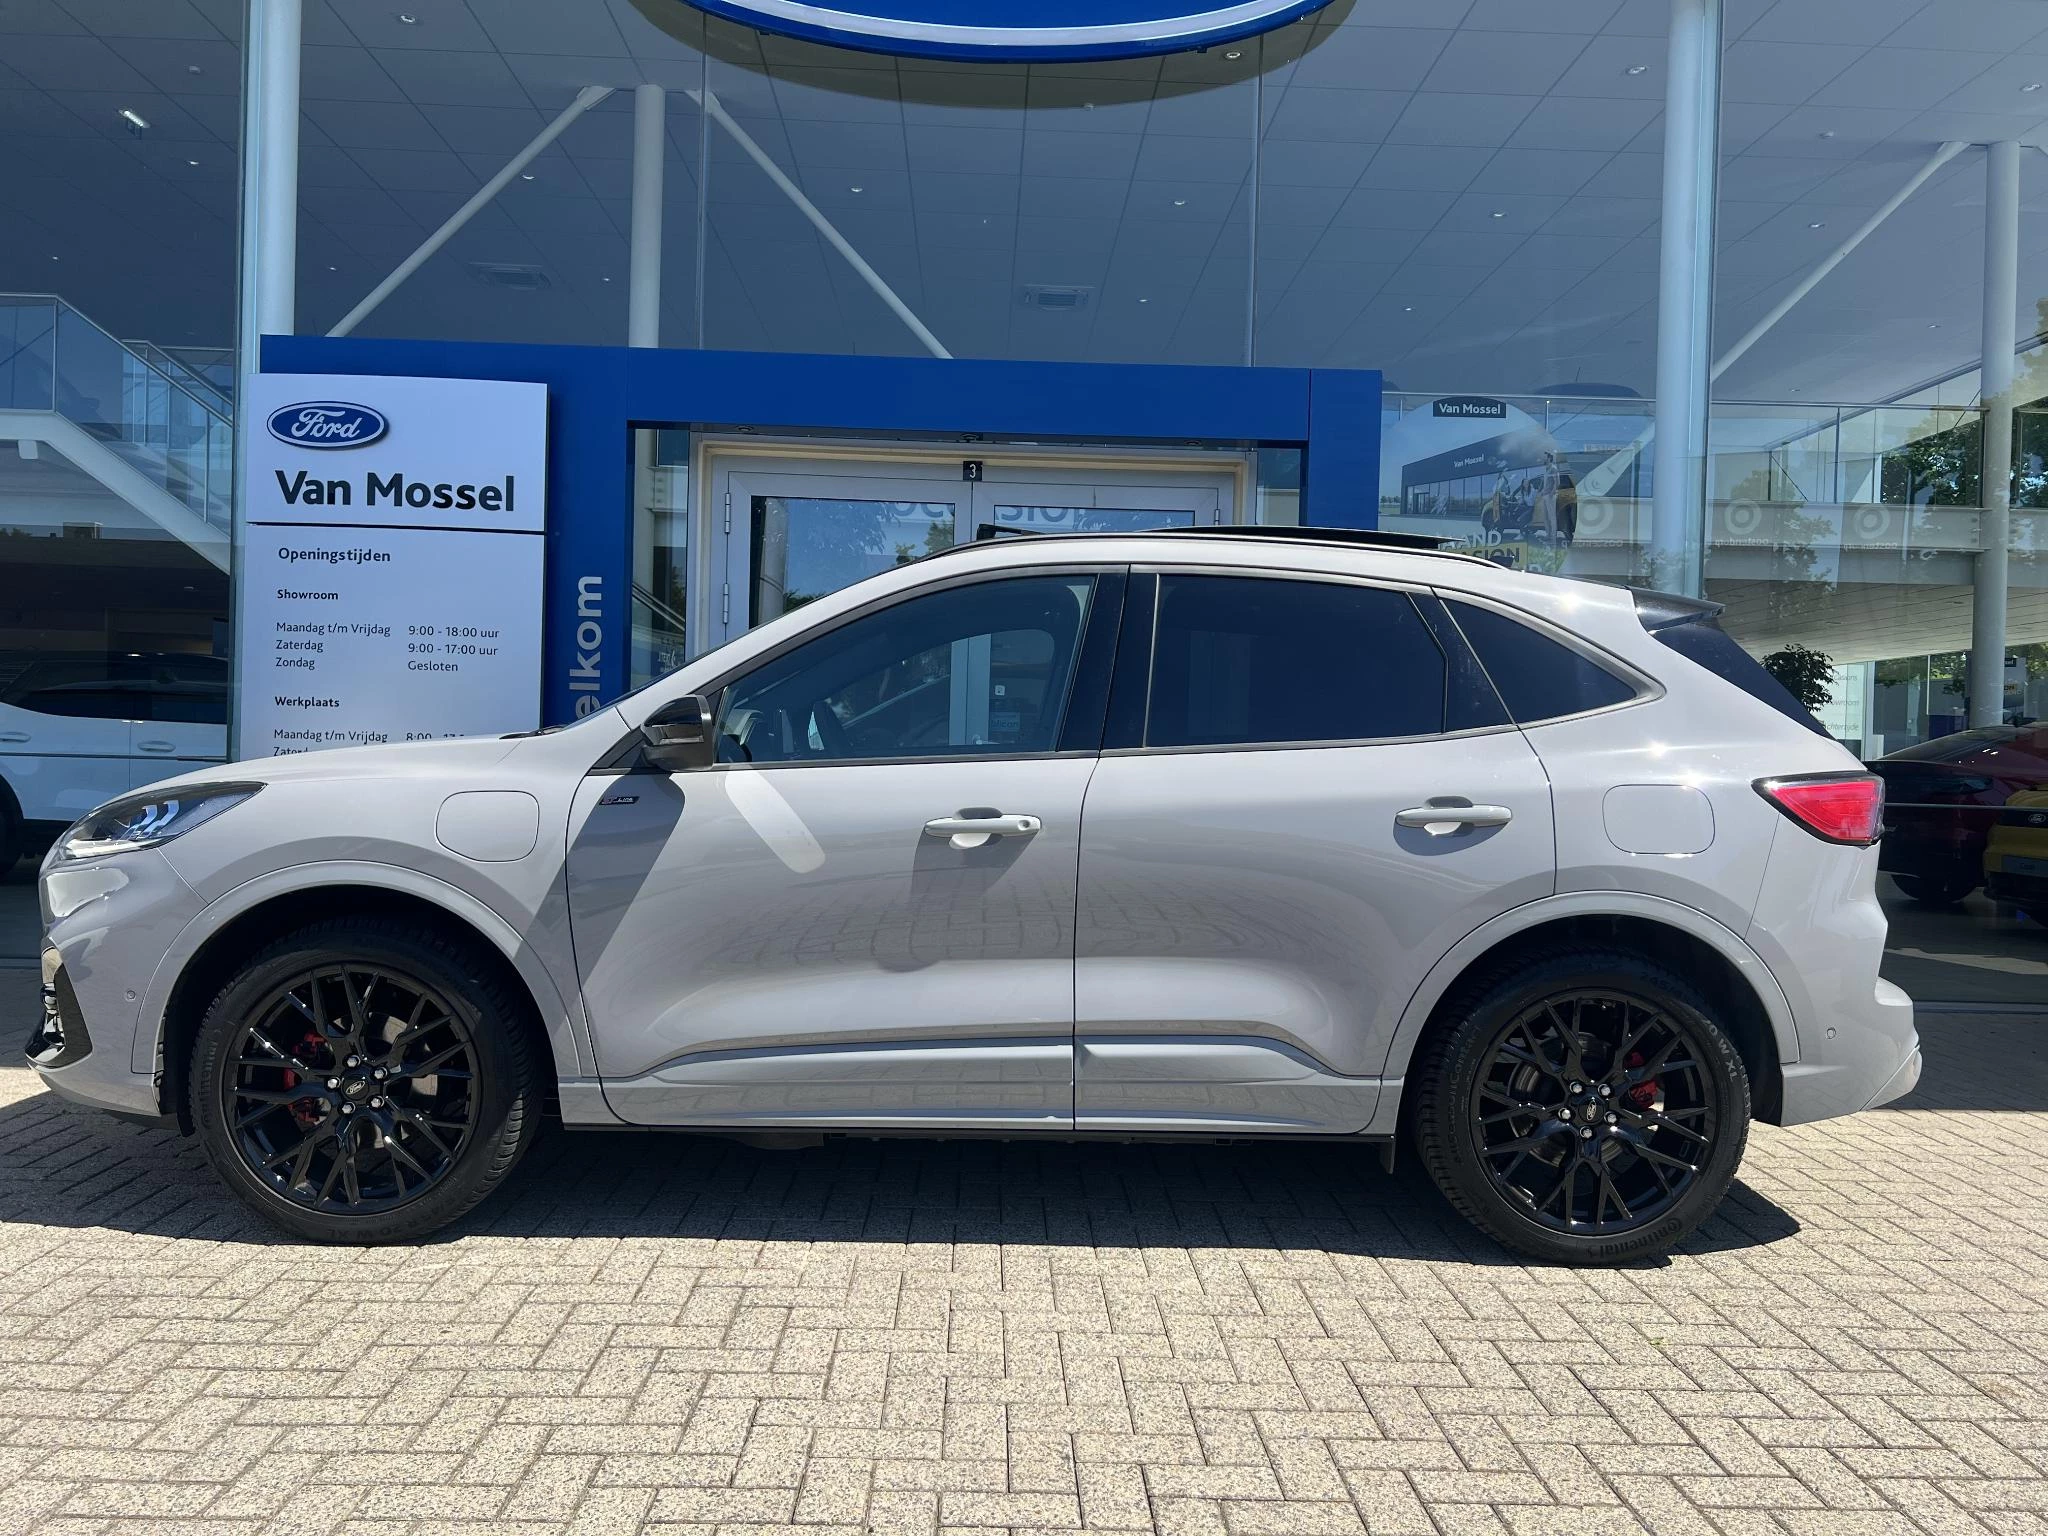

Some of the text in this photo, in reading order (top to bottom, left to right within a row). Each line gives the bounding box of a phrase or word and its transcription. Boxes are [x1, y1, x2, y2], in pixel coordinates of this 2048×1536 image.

[1438, 403, 1501, 414] Van Mossel
[968, 463, 977, 479] 3
[275, 470, 514, 511] Van Mossel
[278, 547, 391, 565] Openingstijden
[277, 589, 339, 600] Showroom
[276, 622, 391, 638] Maandag t/m Vrijdag
[408, 625, 434, 636] 9:00
[445, 626, 477, 637] 18:00
[480, 630, 500, 638] uur
[275, 640, 324, 653] Zaterdag
[408, 643, 434, 653] 9:00
[444, 644, 476, 655] 17:00
[479, 647, 499, 656] uur
[569, 576, 603, 719] elkom
[275, 657, 316, 671] Zondag
[407, 660, 459, 672] Gesloten
[274, 696, 341, 710] Werkplaats
[273, 729, 388, 745] Maandag t/m Vrijdag
[273, 747, 309, 756] Zater
